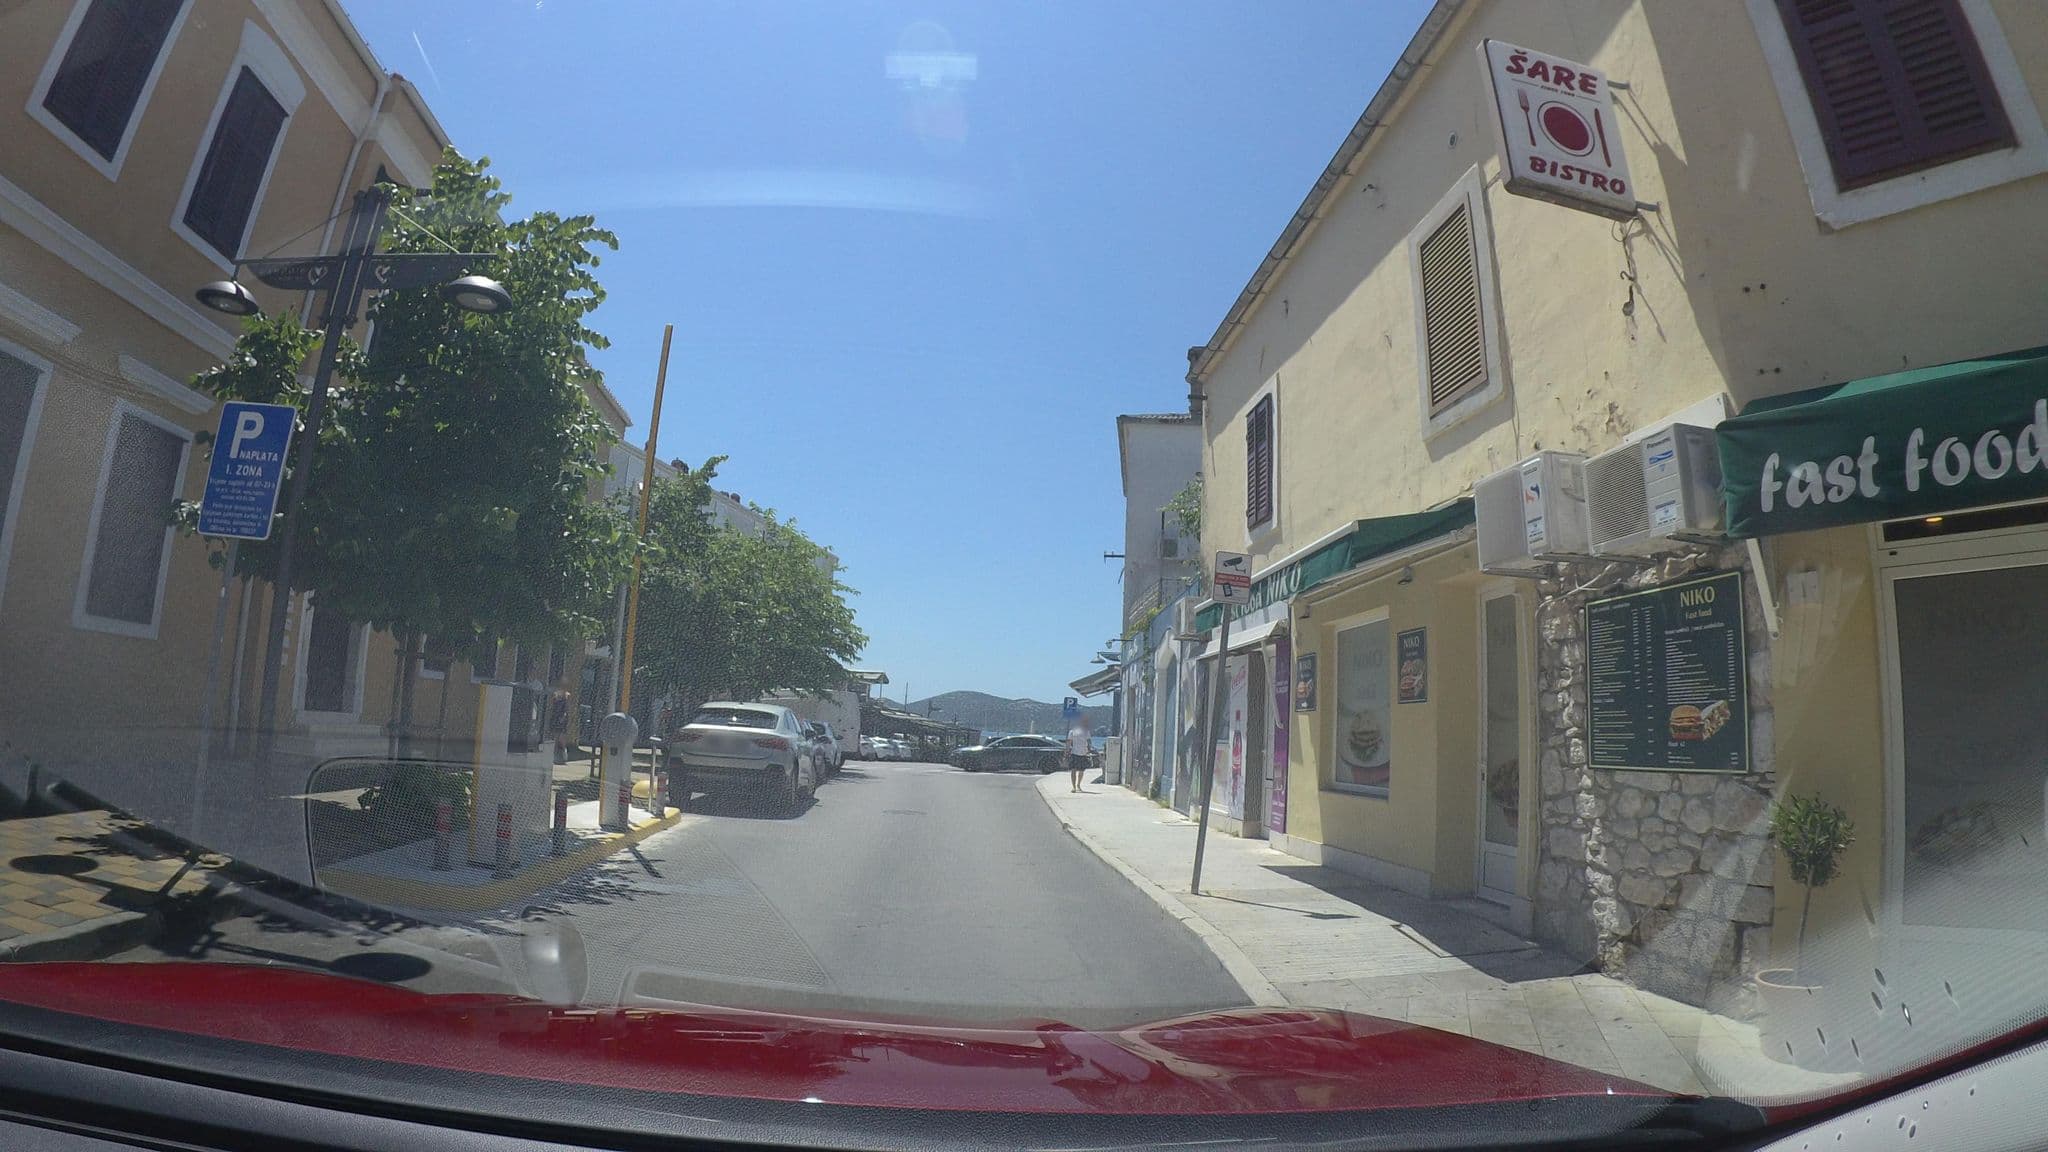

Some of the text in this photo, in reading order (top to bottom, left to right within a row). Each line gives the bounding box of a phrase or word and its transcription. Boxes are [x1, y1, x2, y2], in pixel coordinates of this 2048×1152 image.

[1506, 49, 1598, 96] ŠARE
[1529, 156, 1626, 195] BISTRO
[229, 411, 265, 459] P
[235, 464, 263, 477] ZONA
[239, 449, 279, 463] NAPLATA
[1761, 398, 2048, 513] fast food
[1266, 562, 1303, 606] NIKO
[1679, 586, 1716, 608] NIKO
[1066, 699, 1075, 709] P
